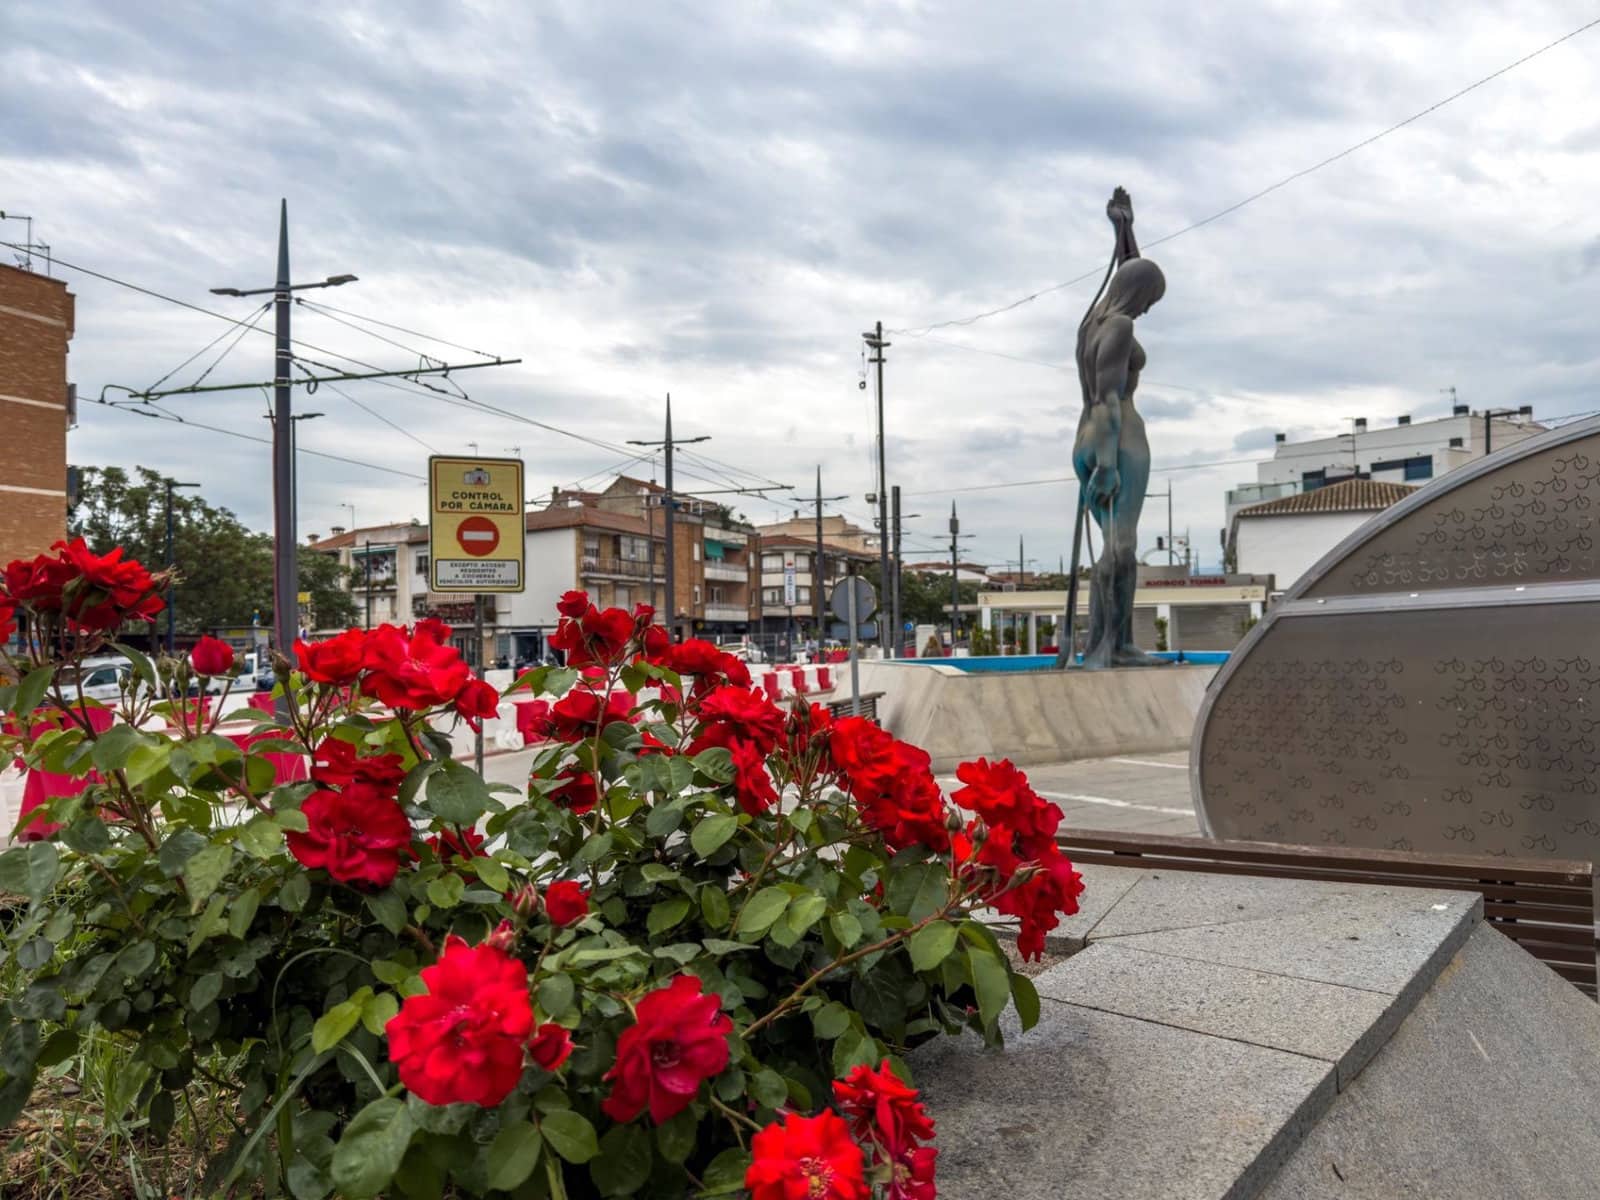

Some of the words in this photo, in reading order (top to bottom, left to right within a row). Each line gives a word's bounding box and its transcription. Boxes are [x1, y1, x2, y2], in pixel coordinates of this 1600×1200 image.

[452, 491, 504, 500] CONTROL
[441, 501, 463, 509] POR
[469, 500, 513, 510] CÁMARA
